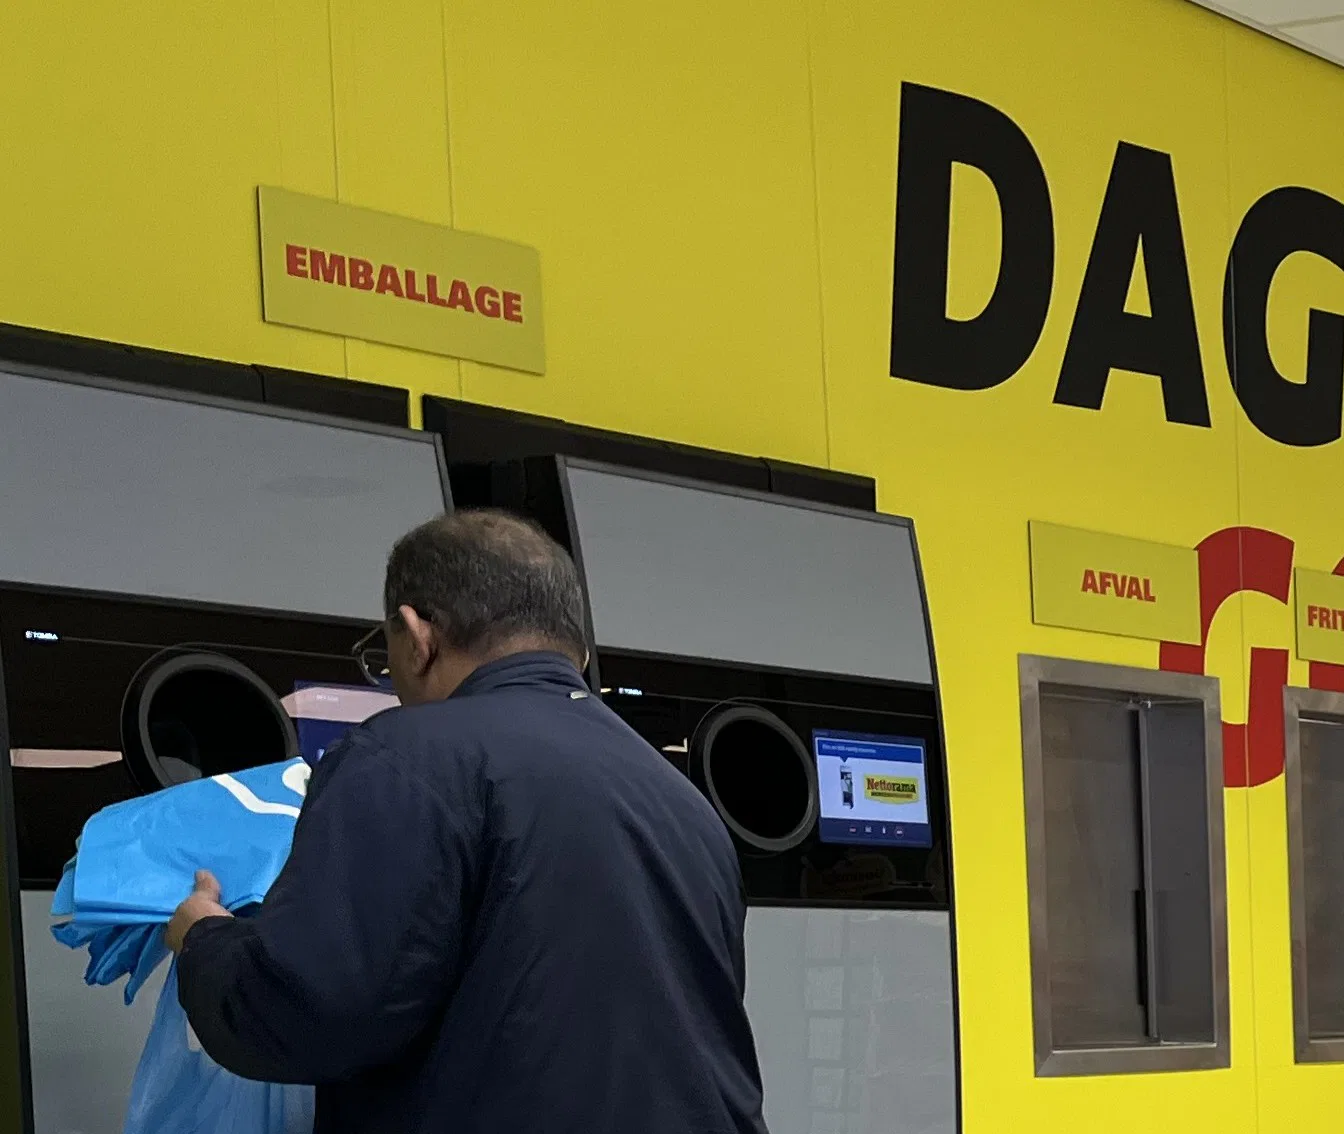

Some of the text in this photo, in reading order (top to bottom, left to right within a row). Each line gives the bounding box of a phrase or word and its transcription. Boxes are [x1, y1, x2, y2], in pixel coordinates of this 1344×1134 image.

[285, 243, 524, 323] EMBALLAGE
[1081, 569, 1156, 603] AFVAL
[866, 777, 917, 793] Nettorama
